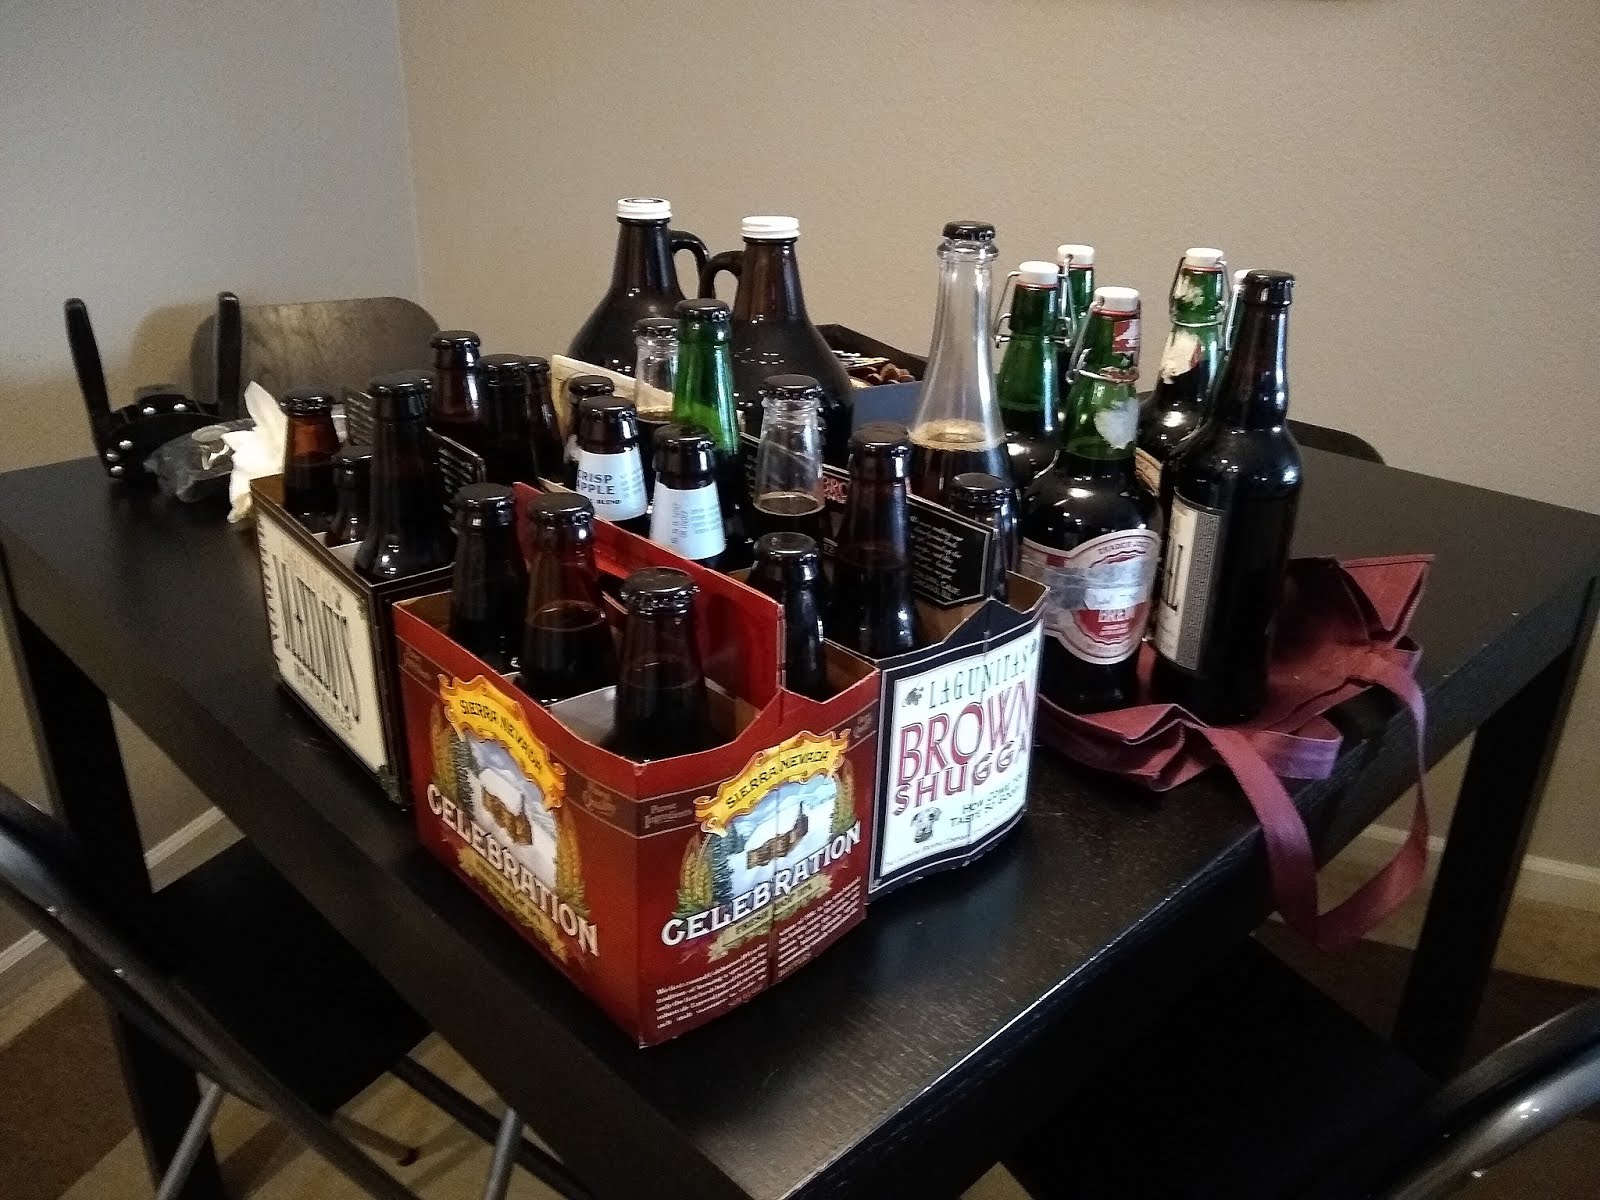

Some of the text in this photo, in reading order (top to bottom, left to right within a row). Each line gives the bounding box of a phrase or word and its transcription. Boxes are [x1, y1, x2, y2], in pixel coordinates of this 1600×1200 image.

[459, 699, 497, 723] SIERRA
[928, 647, 1029, 709] LAGUNITAS
[898, 681, 1034, 785] BROWN
[725, 750, 829, 809] SIERRA NEVADA
[427, 783, 599, 957] CELEBRATION
[661, 821, 861, 947] CELEBRATION
